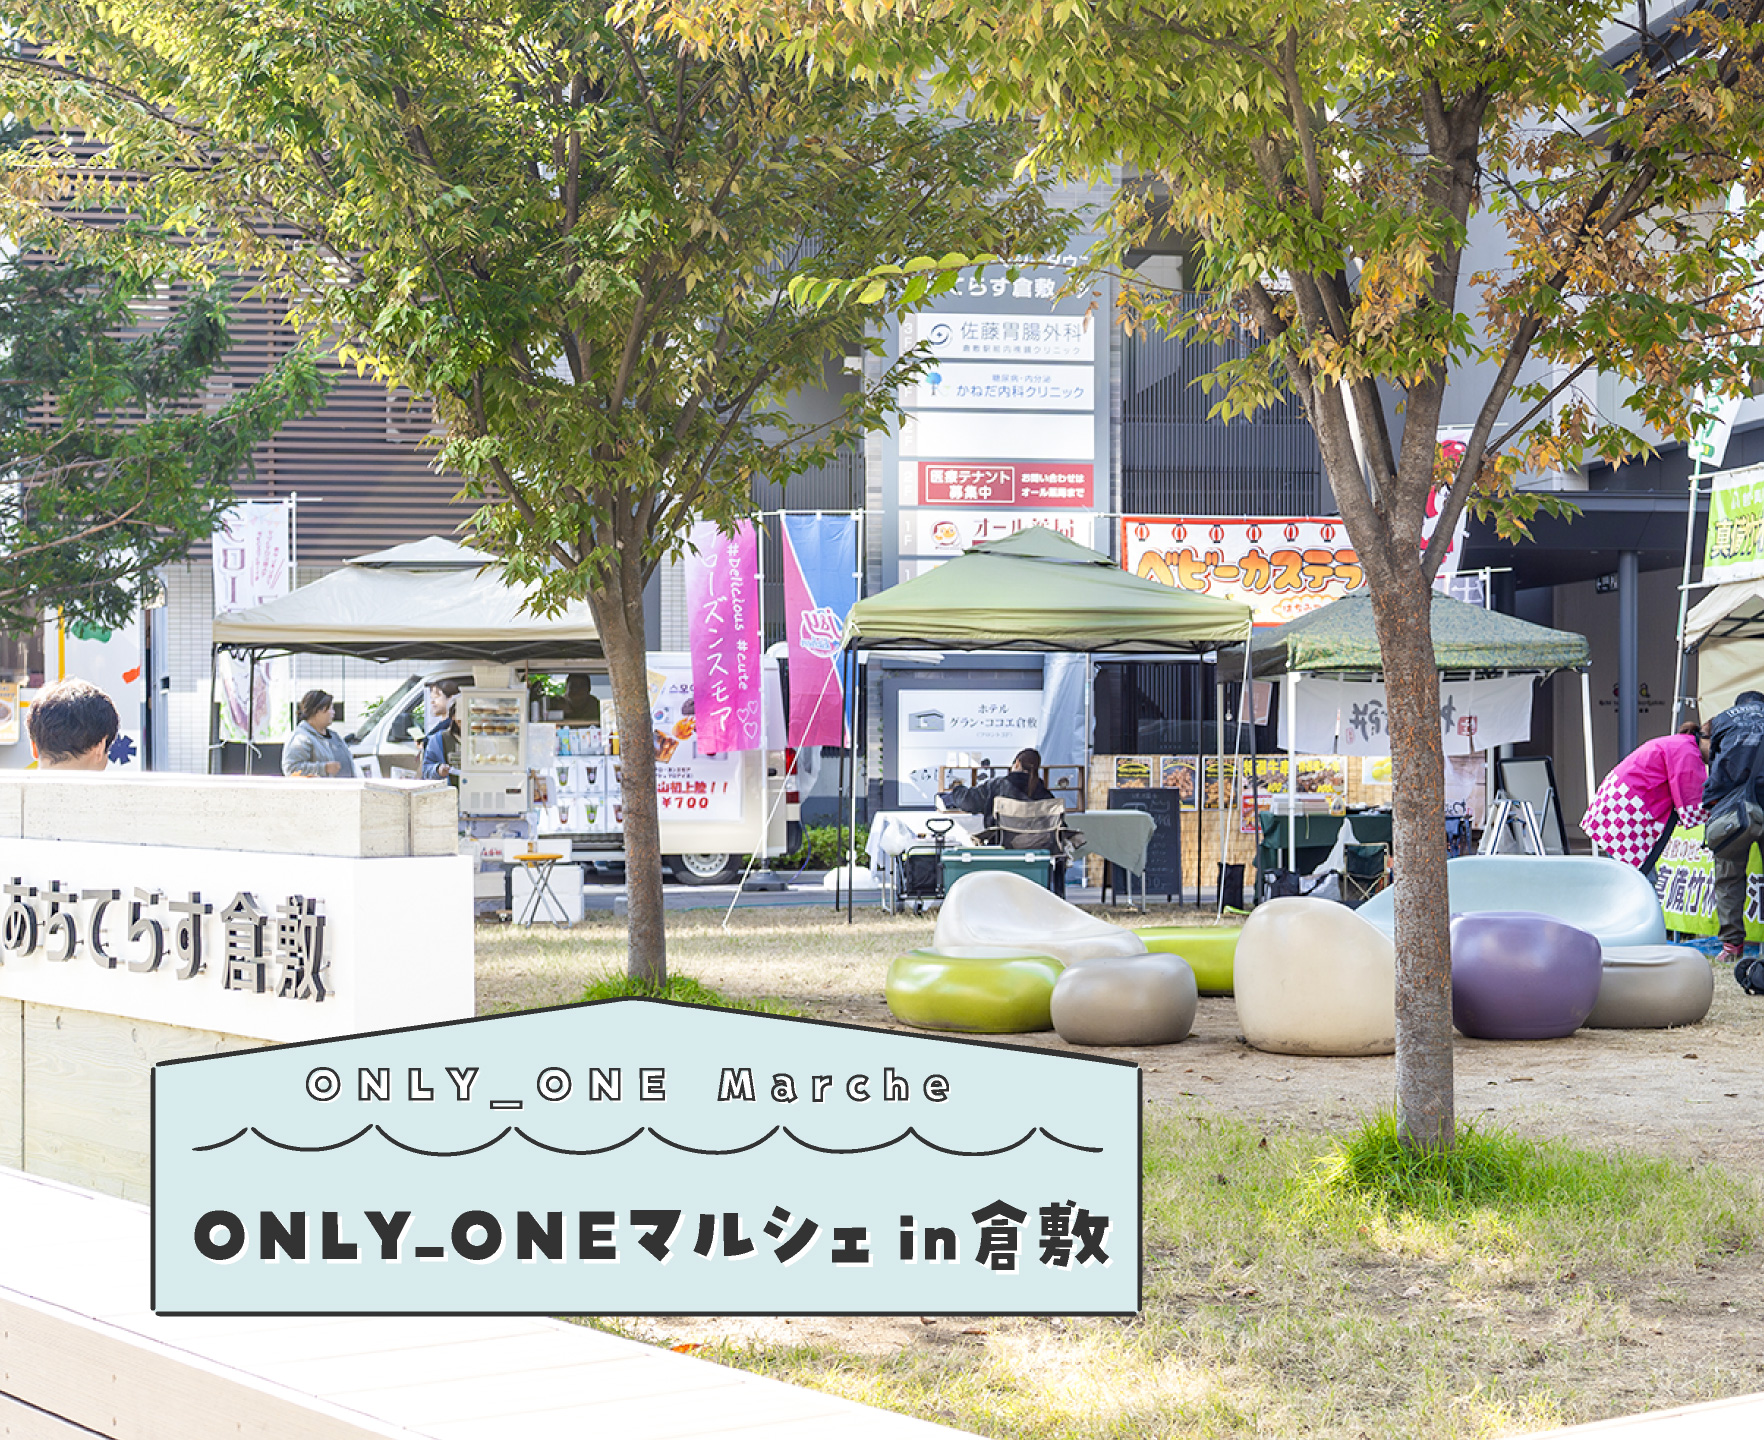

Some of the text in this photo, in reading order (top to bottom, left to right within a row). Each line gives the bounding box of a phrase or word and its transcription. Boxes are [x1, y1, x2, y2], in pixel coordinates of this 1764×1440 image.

[961, 321, 1082, 343] 佐藤胃腸外科
[956, 385, 1085, 398] かねだ内科クリニック
[930, 470, 1010, 484] 医療テナント
[949, 485, 992, 500] 募集中
[1137, 548, 1364, 591] ベビーカステラ
[737, 639, 749, 691] #cute
[2, 876, 327, 1003] あちてらす倉敷
